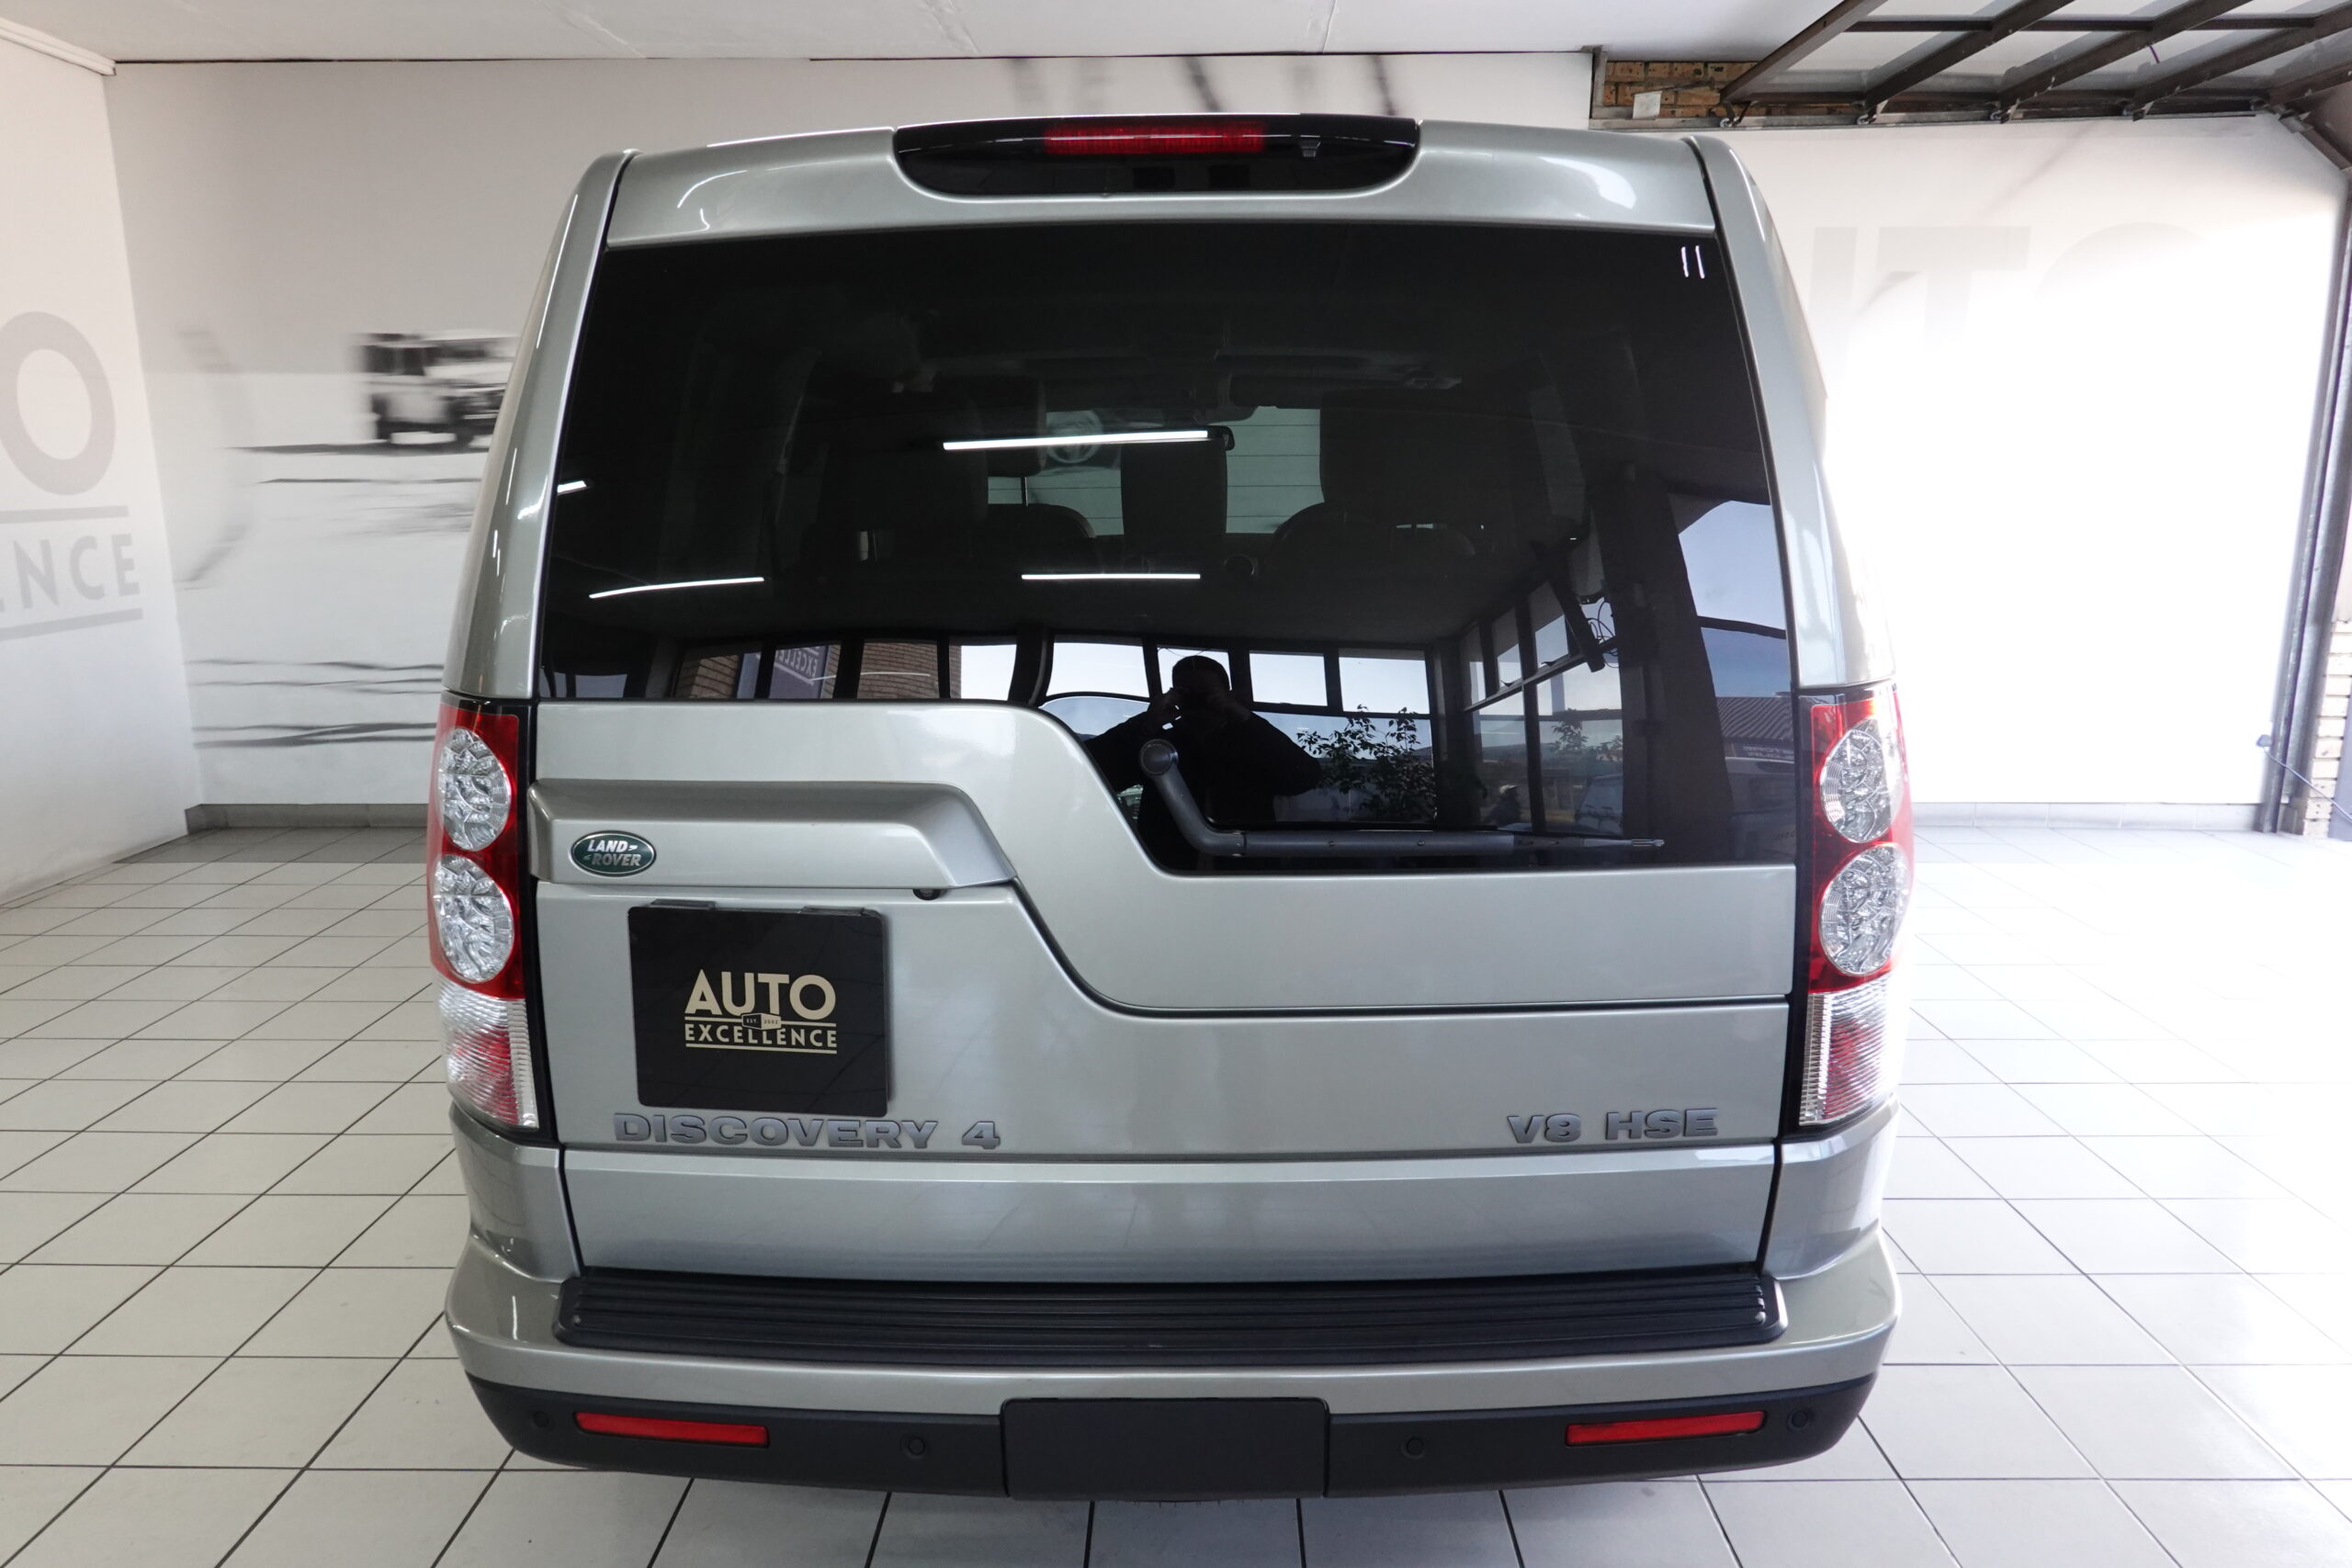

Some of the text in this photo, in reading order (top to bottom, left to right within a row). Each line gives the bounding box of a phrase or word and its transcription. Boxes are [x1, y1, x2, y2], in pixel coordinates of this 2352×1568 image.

[0, 533, 140, 613] NCE
[588, 840, 628, 853] LAND
[592, 853, 642, 866] ROVER
[684, 969, 836, 1021] AUTO
[684, 1023, 837, 1047] EXCELLENCE
[614, 1112, 1001, 1150] DISCOVERY 4
[1507, 1108, 1719, 1144] V8 HSE
